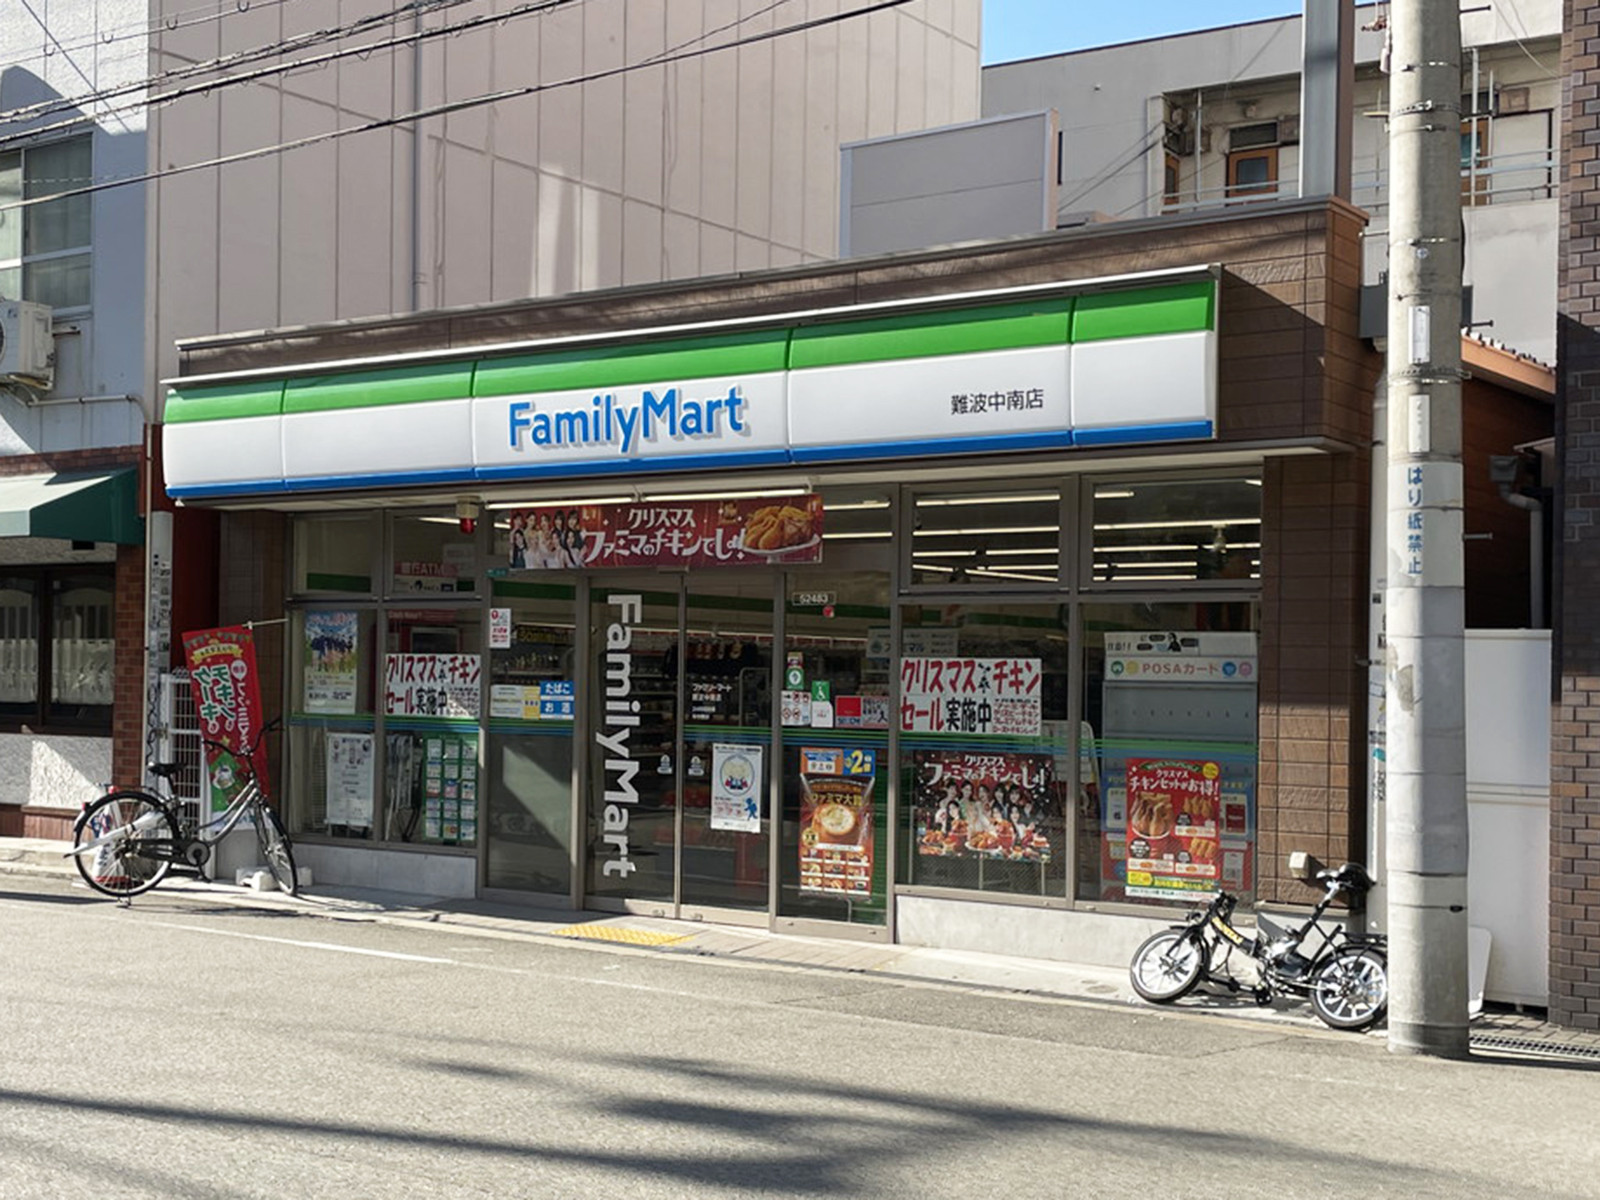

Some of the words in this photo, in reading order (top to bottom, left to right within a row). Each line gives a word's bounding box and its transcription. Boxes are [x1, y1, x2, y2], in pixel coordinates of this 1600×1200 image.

[951, 388, 1044, 415] 難波中南店
[509, 387, 743, 453] FamilyMart
[628, 508, 697, 529] クリスマス
[1408, 466, 1423, 574] はり紙禁止
[386, 655, 437, 682] クリスマス
[449, 656, 480, 684] チキン
[902, 659, 976, 693] クリスマス
[993, 660, 1040, 695] チキン
[1142, 663, 1219, 676] POSAカード
[386, 686, 448, 715] セール実施中
[545, 683, 571, 694] たばこ
[901, 696, 992, 733] セール実施中
[596, 594, 642, 877] FamilyMart
[965, 755, 1006, 767] クリスマス
[1156, 769, 1189, 779] クリスマス
[1128, 776, 1219, 801] チキンセットがお得!
